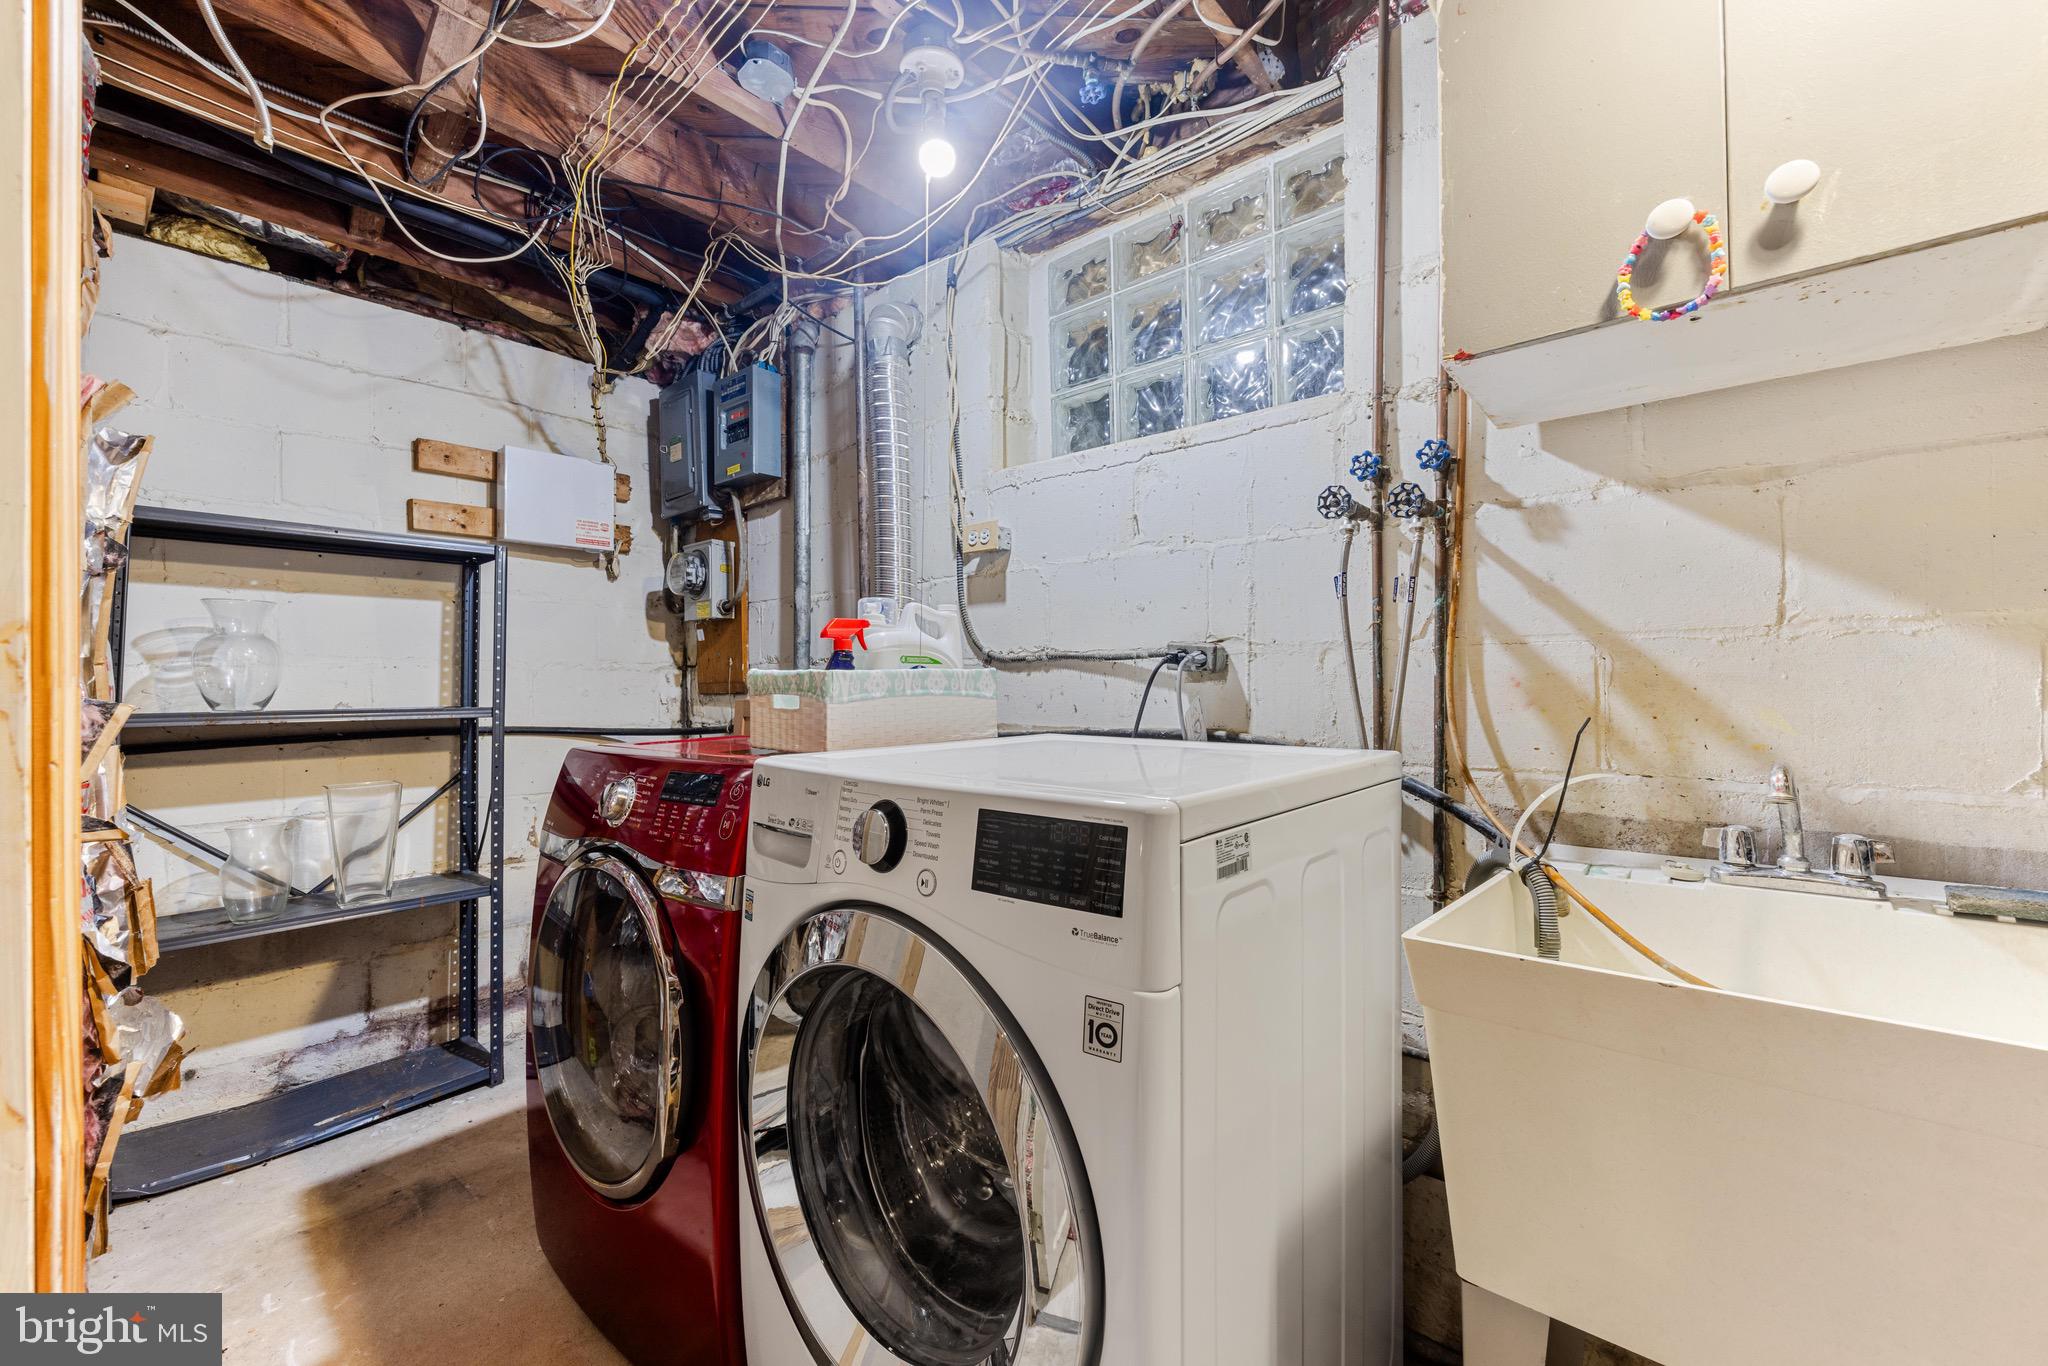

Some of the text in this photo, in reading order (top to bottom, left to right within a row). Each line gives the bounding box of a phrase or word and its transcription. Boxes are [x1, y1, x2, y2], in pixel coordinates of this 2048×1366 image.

[763, 777, 771, 787] LG
[917, 796, 929, 805] Bright
[920, 807, 943, 817] Perm Press
[922, 819, 942, 828] Delicates
[926, 830, 941, 838] Towels
[914, 840, 927, 849] Speed
[912, 850, 939, 861] Downloaded
[1026, 888, 1037, 897] Spin
[1088, 1003, 1120, 1016] Direct Drive
[1088, 1019, 1118, 1049] 10
[1100, 1032, 1112, 1040] YEAR
[1088, 1046, 1116, 1057] WARRANTY
